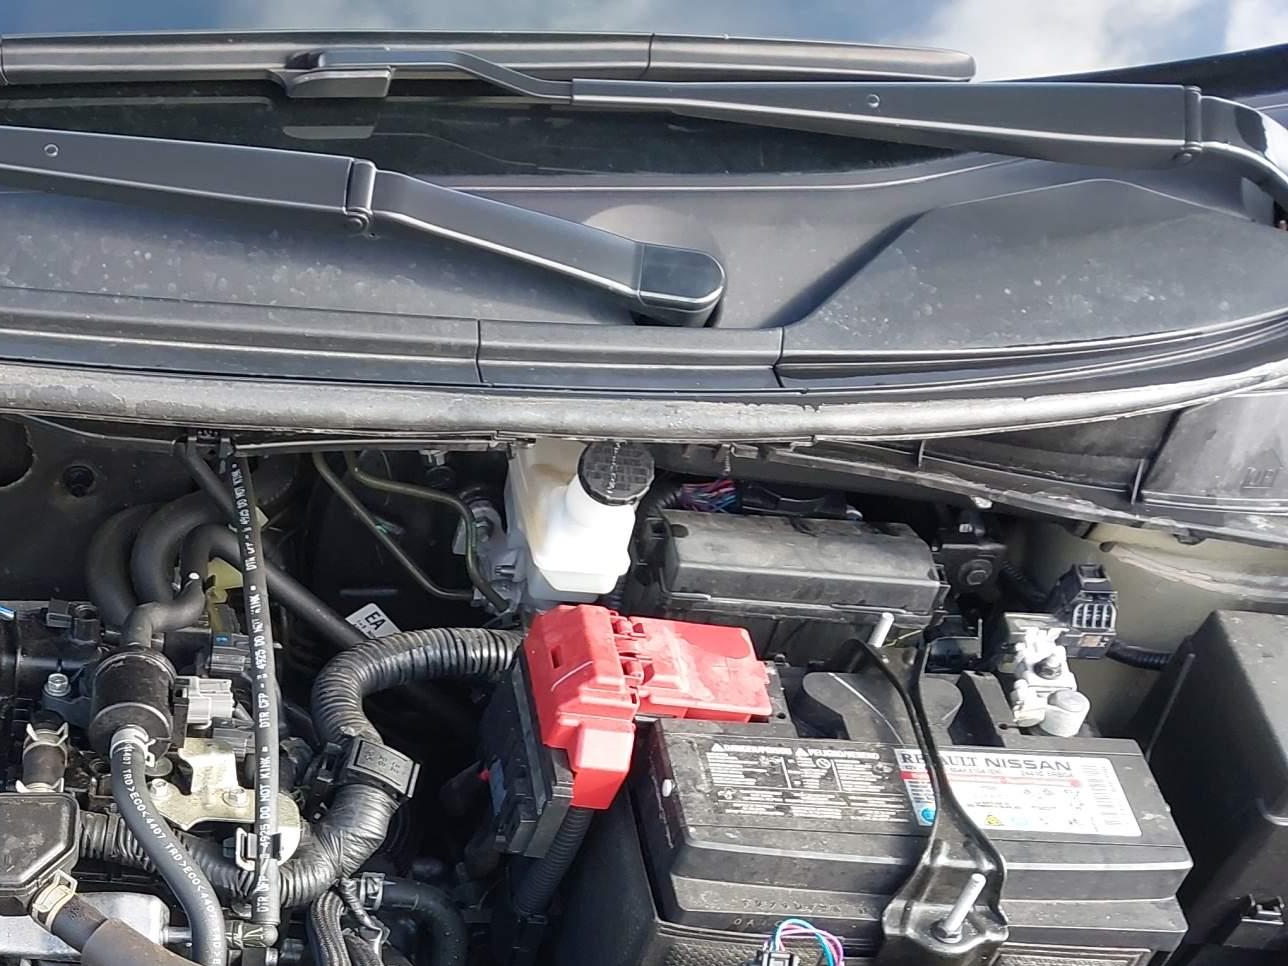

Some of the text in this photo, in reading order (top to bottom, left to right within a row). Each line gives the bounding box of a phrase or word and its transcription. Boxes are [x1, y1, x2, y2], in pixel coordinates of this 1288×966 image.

[364, 611, 386, 630] EA
[252, 635, 264, 646] DO
[253, 649, 266, 669] 4925
[258, 711, 270, 728] DTR
[260, 756, 270, 778] KINK
[901, 753, 977, 768] REAULT
[984, 757, 1072, 771] NISSAN
[260, 784, 270, 800] NOT
[260, 806, 270, 818] DO
[257, 895, 268, 912] DTR
